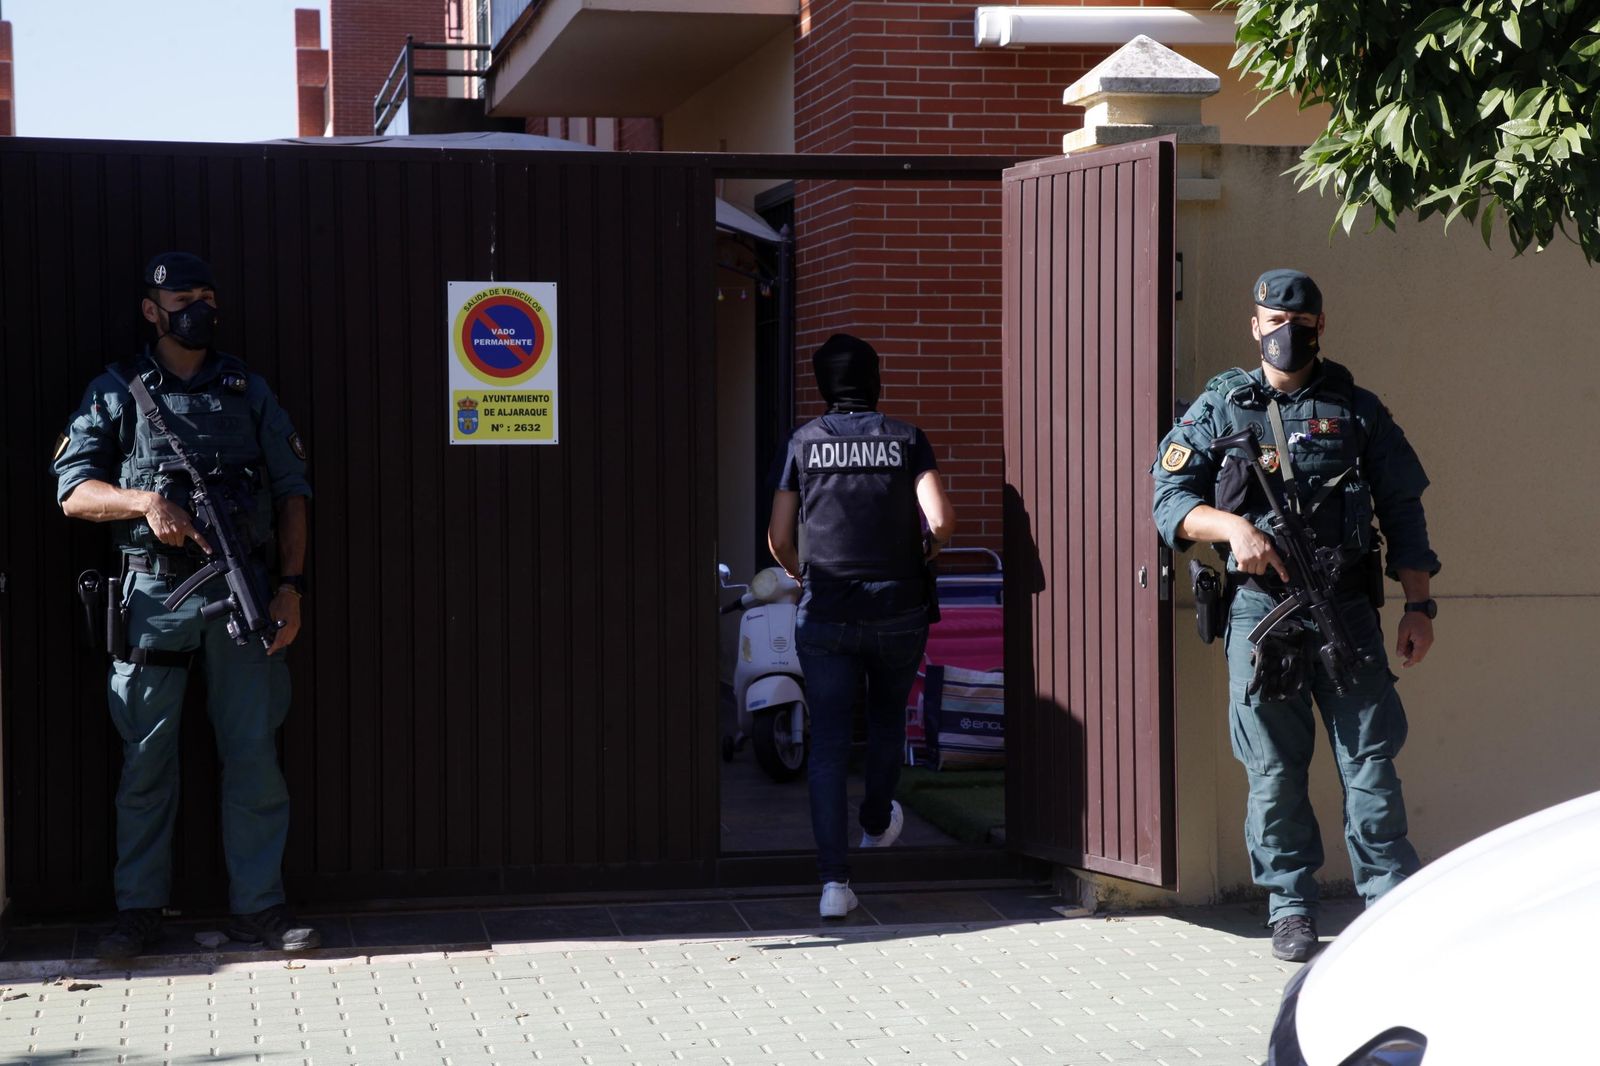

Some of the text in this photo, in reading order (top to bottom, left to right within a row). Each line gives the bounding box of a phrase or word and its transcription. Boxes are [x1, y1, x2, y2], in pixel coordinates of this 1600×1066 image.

[464, 291, 488, 312] SALIDA
[489, 288, 500, 296] DE
[491, 328, 516, 336] VADO
[474, 338, 533, 346] PERMANENTE
[482, 394, 550, 403] AYUNTAMIENTO
[484, 408, 548, 417] DE ALJARAQUE
[514, 423, 541, 432] 2632
[808, 441, 902, 468] ADUANAS
